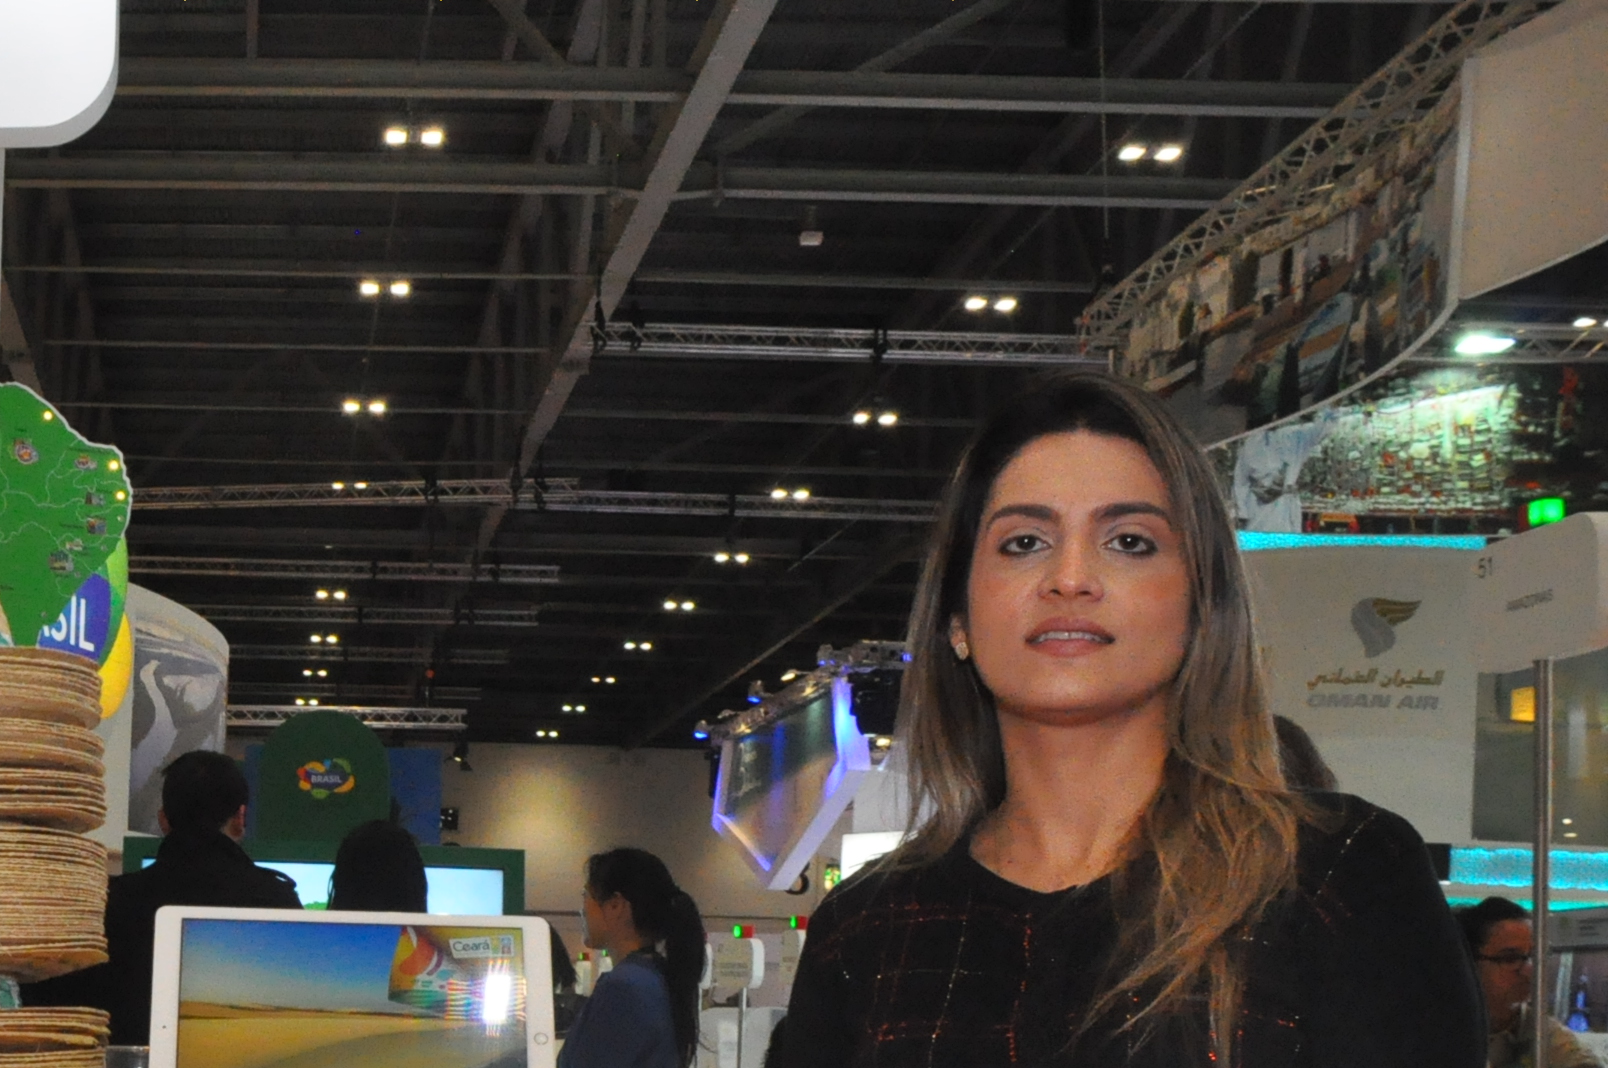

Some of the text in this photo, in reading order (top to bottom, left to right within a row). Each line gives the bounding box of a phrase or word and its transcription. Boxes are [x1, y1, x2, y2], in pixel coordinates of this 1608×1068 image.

[43, 595, 96, 652] SIL
[1307, 693, 1440, 710] OMAN AIR
[310, 774, 342, 784] BRASIL
[452, 938, 490, 952] Ceará
